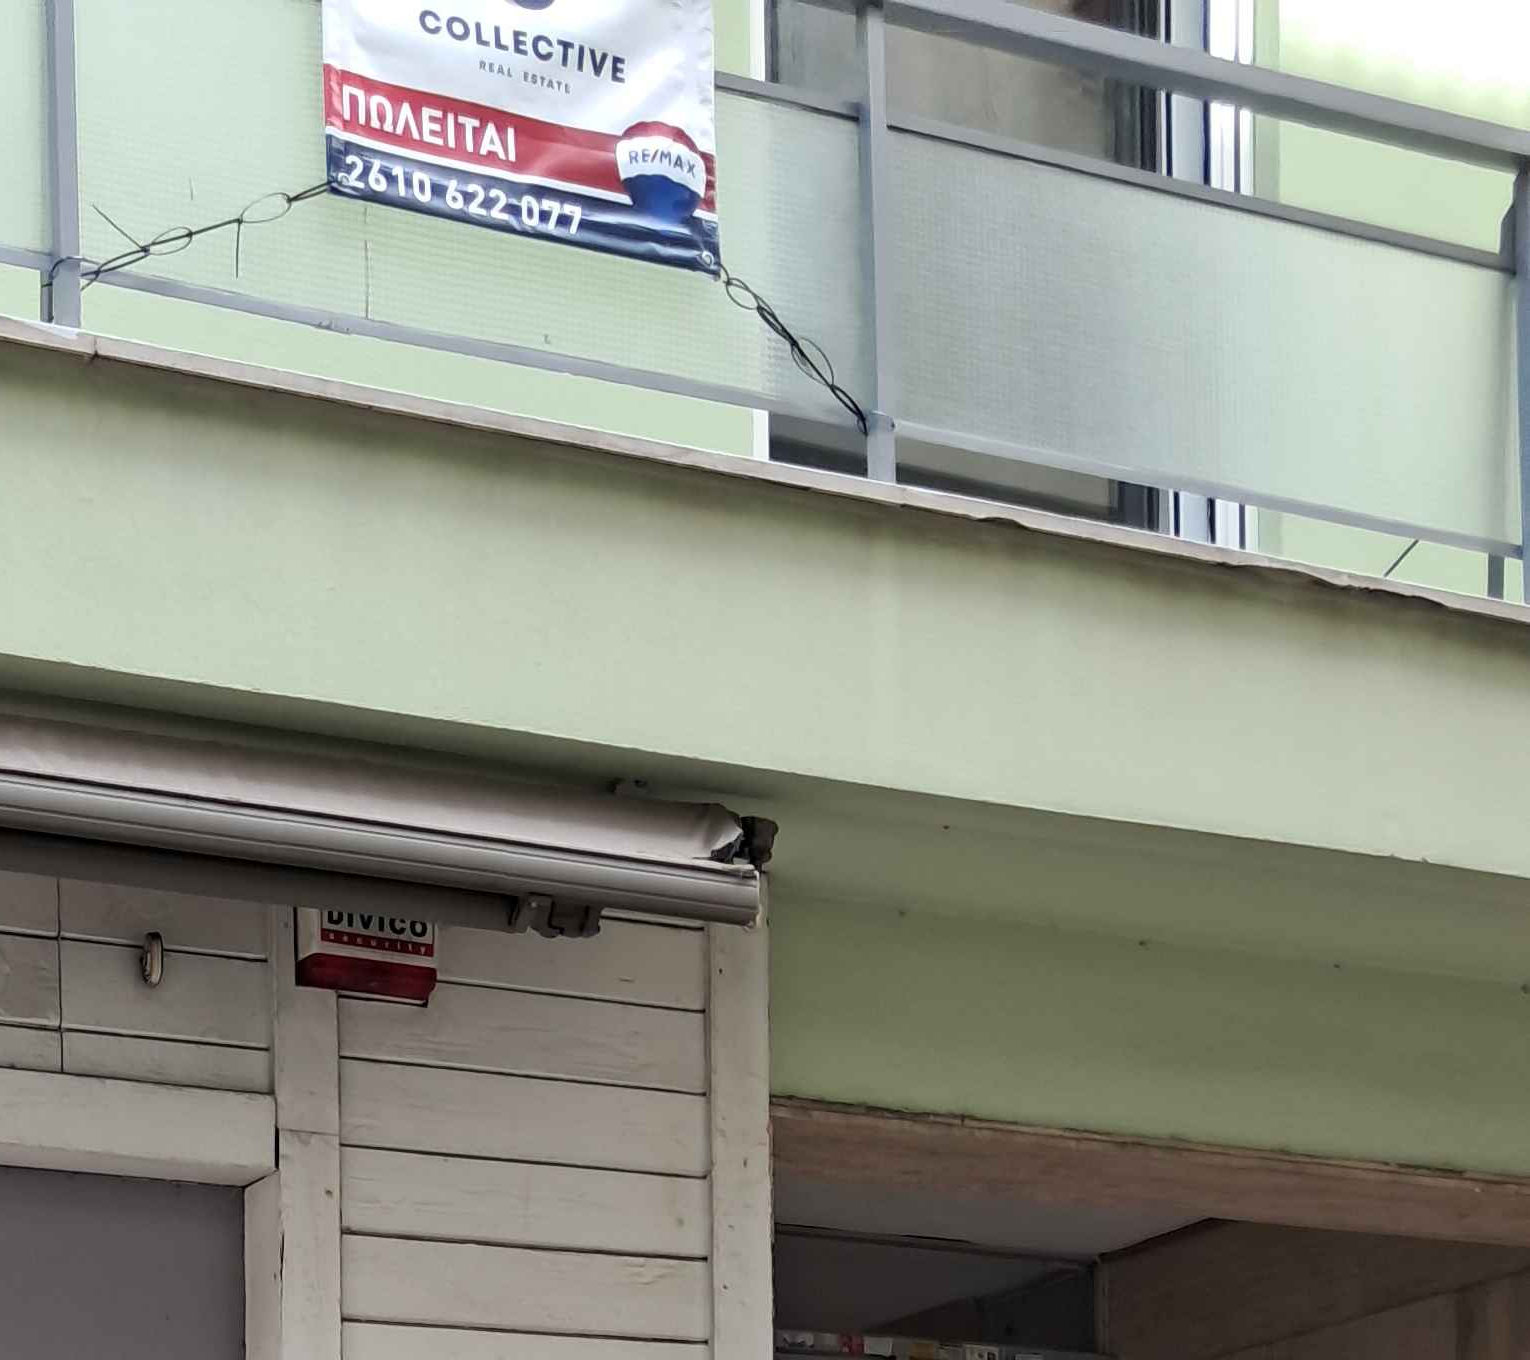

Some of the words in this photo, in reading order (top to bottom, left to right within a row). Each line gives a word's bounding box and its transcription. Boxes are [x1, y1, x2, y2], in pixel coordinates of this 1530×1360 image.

[418, 9, 626, 84] COLLECTIVE
[478, 60, 513, 78] REAL
[523, 73, 572, 94] ESTATE
[341, 84, 517, 163] ΠΩΛΕΙΤΑΙ
[343, 153, 432, 203] 2610
[444, 181, 510, 221] 622
[520, 194, 583, 236] 077
[628, 149, 697, 179] RE/MAX
